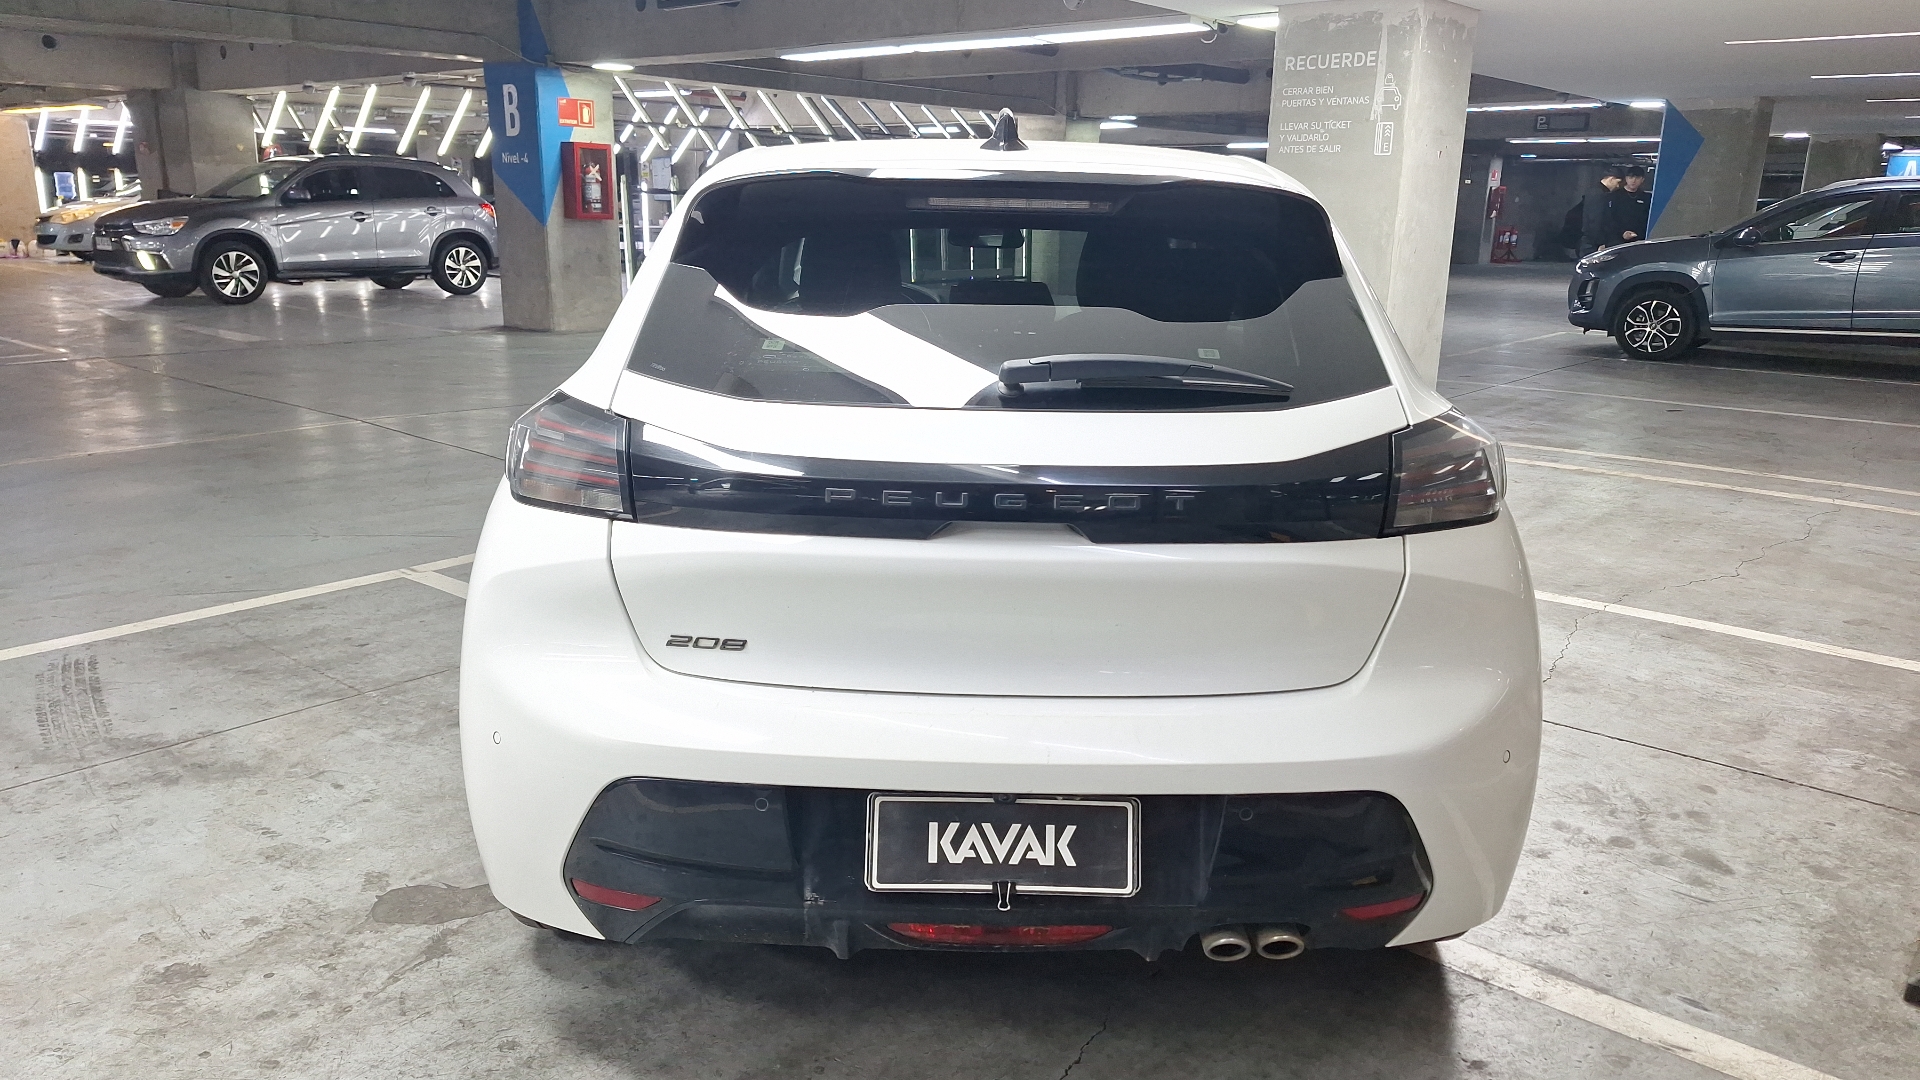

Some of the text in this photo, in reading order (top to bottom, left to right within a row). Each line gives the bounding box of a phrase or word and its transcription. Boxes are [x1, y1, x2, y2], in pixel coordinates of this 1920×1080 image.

[1285, 51, 1377, 71] RECUERDE
[1282, 86, 1334, 96] CERRAR BIEN
[1281, 96, 1370, 108] PUERTAS Y VENTANAS
[502, 83, 521, 137] B
[1280, 122, 1309, 131] LLEVAR
[1310, 121, 1322, 130] SU
[1279, 132, 1329, 142] Y VALIDARLO
[1279, 144, 1341, 154] ANTES DE SALIR
[502, 152, 520, 163] Nivel
[825, 487, 1195, 511] PEUGEOT
[665, 634, 747, 651] 208
[928, 821, 1077, 867] KAVAK
